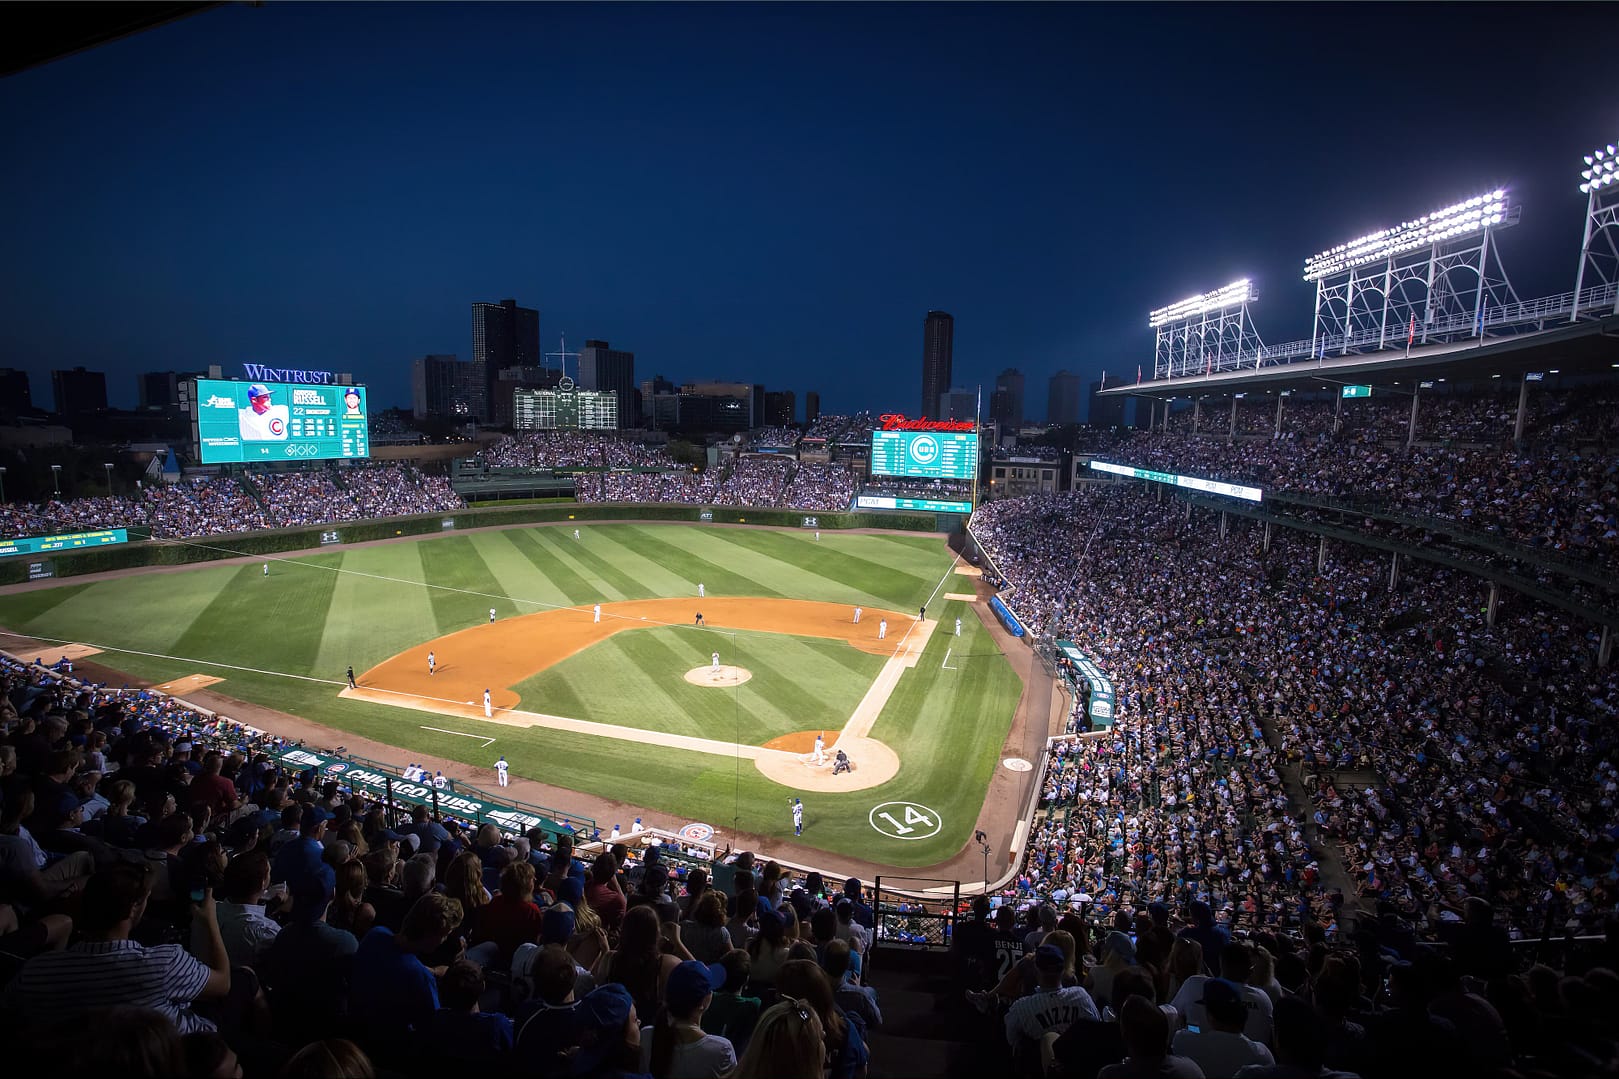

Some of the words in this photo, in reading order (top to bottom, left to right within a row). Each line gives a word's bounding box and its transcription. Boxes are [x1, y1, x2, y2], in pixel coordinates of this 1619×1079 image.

[293, 395, 326, 405] RUSSELL
[293, 407, 305, 415] 22
[881, 414, 974, 430] Budweiser
[0, 546, 18, 554] USSELL
[425, 792, 482, 813] CUBS
[879, 806, 934, 835] 14
[1036, 1005, 1079, 1030] RIZZO
